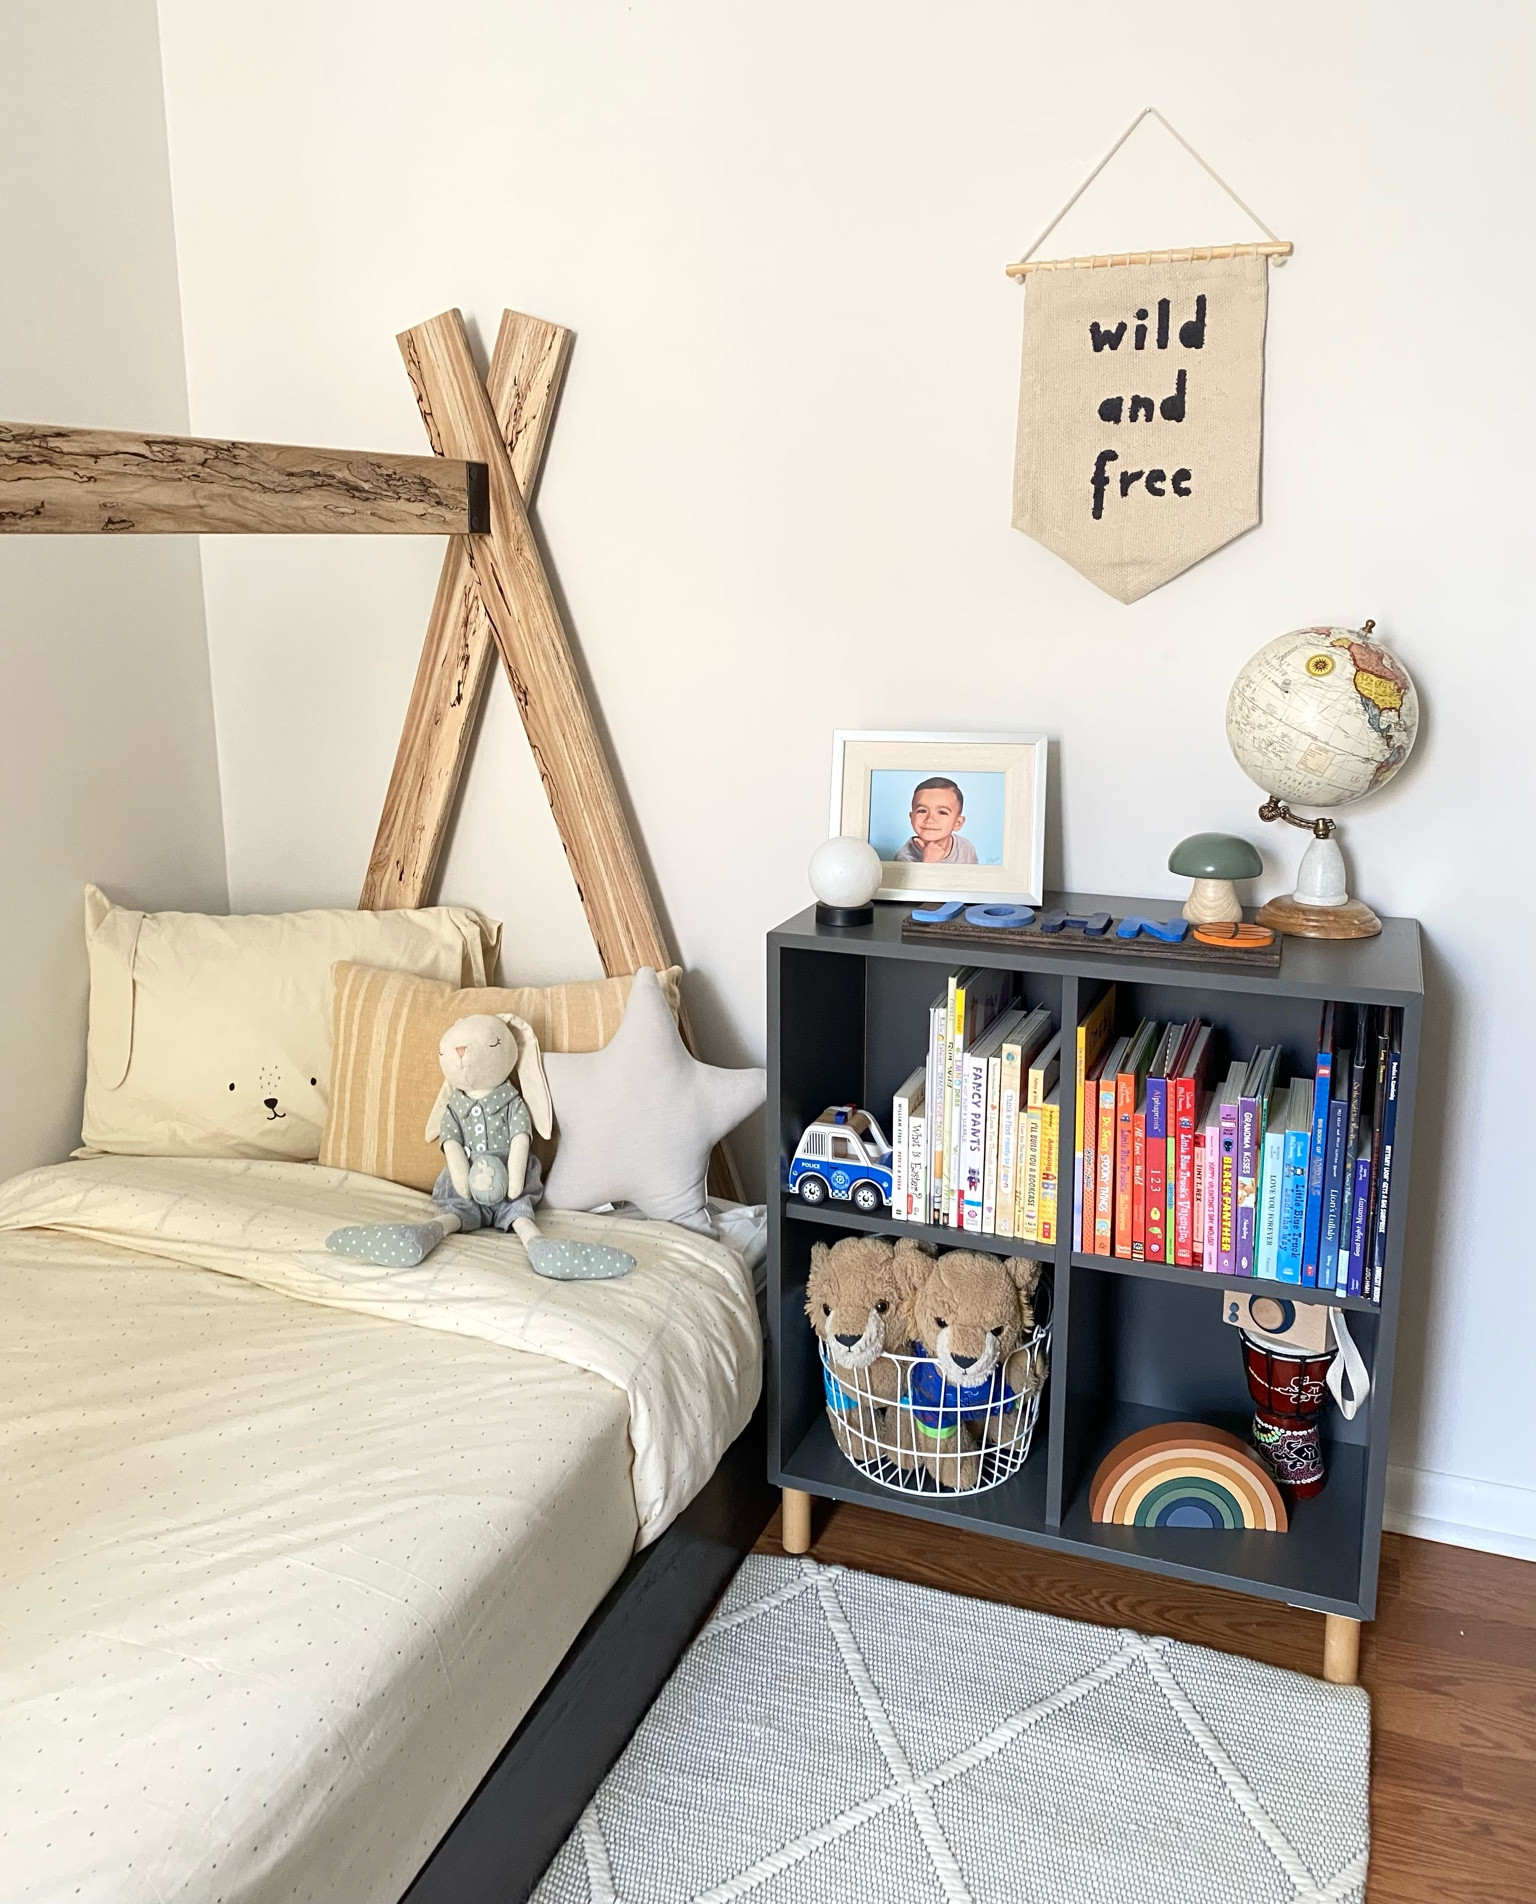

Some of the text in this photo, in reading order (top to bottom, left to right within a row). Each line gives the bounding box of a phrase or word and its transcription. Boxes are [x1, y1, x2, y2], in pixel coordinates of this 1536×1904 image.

[1089, 294, 1207, 353] wild
[1097, 368, 1188, 424] and
[1090, 449, 1193, 520] free
[911, 901, 1191, 943] JOHN
[953, 1088, 961, 1108] peas
[969, 1067, 983, 1153] FANCY PANTS
[1006, 1094, 1014, 1113] Think
[1351, 1099, 1360, 1113] Night
[911, 1124, 923, 1147] What
[1005, 1120, 1013, 1136] Find
[1030, 1122, 1038, 1133] I'LL
[1120, 1129, 1131, 1148] Little
[1243, 1112, 1254, 1149] GRANDMA
[1030, 1134, 1038, 1153] BUILD
[1120, 1149, 1131, 1165] Blue
[1315, 1146, 1321, 1155] OF
[801, 1161, 820, 1169] POLICE
[1029, 1154, 1037, 1167] YOU
[1041, 1138, 1056, 1201] Amazing ABC
[1098, 1115, 1111, 1213] Dr. Seuss's SPOOKY THINGS
[1208, 1161, 1216, 1181] HAPPY
[910, 1162, 922, 1199] Easter?
[1120, 1166, 1130, 1193] Truck's
[1134, 1165, 1144, 1186] World
[1178, 1133, 1192, 1244] Little Blue Truck's Valentine
[1381, 1181, 1390, 1195] GETS
[1027, 1174, 1036, 1207] BOOKCASE
[1329, 1189, 1339, 1213] Lion's
[1220, 1156, 1234, 1253] BLACK PANTHER
[1265, 1174, 1277, 1247] LOVE YOU FOREVER
[1279, 1188, 1294, 1253] Leads the Way
[1291, 1184, 1305, 1259] Little Blue Truck
[1325, 1214, 1337, 1242] Lullaby
[1353, 1196, 1367, 1257] Good Night Mommy
[1378, 1208, 1387, 1233] SURPRISE
